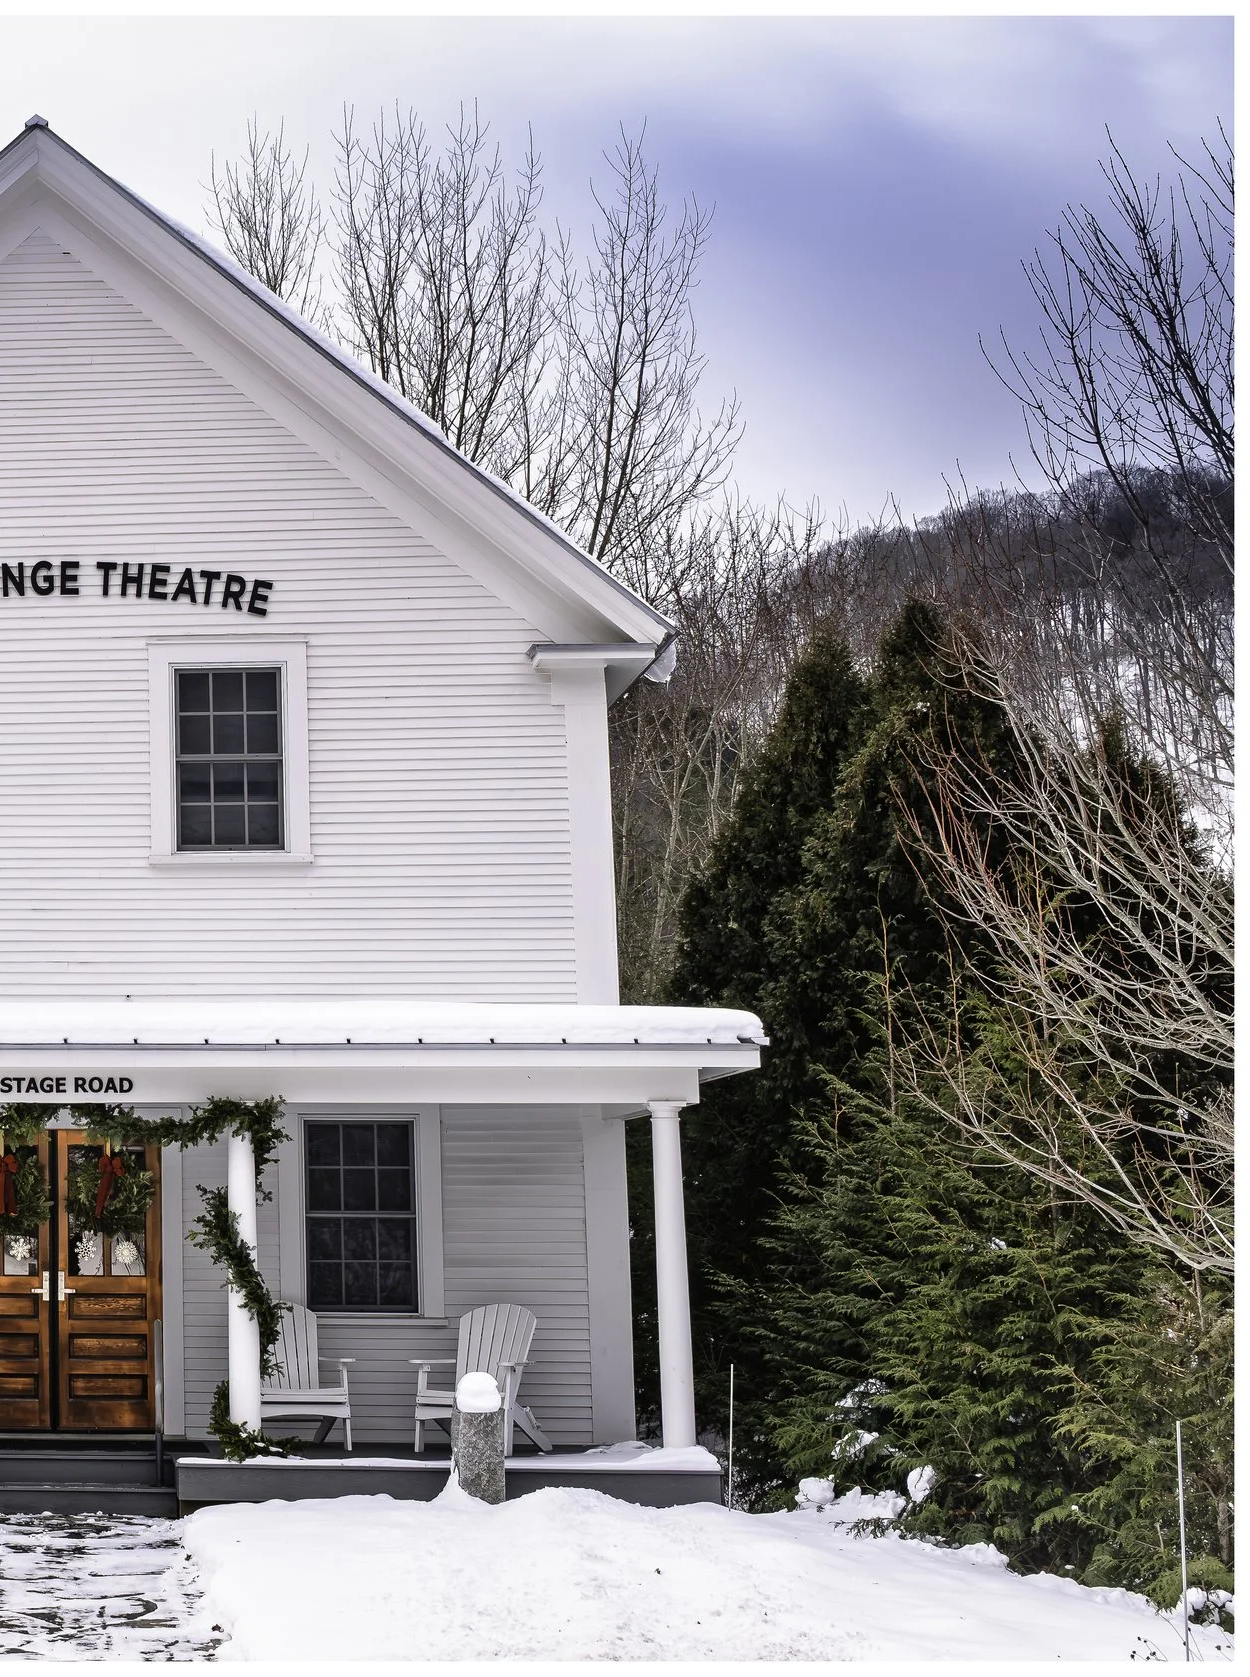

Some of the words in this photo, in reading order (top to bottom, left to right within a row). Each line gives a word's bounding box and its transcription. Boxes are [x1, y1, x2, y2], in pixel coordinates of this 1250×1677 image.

[96, 561, 274, 617] THEATRE
[0, 1077, 67, 1094] STAGE
[74, 1077, 134, 1094] ROAD
